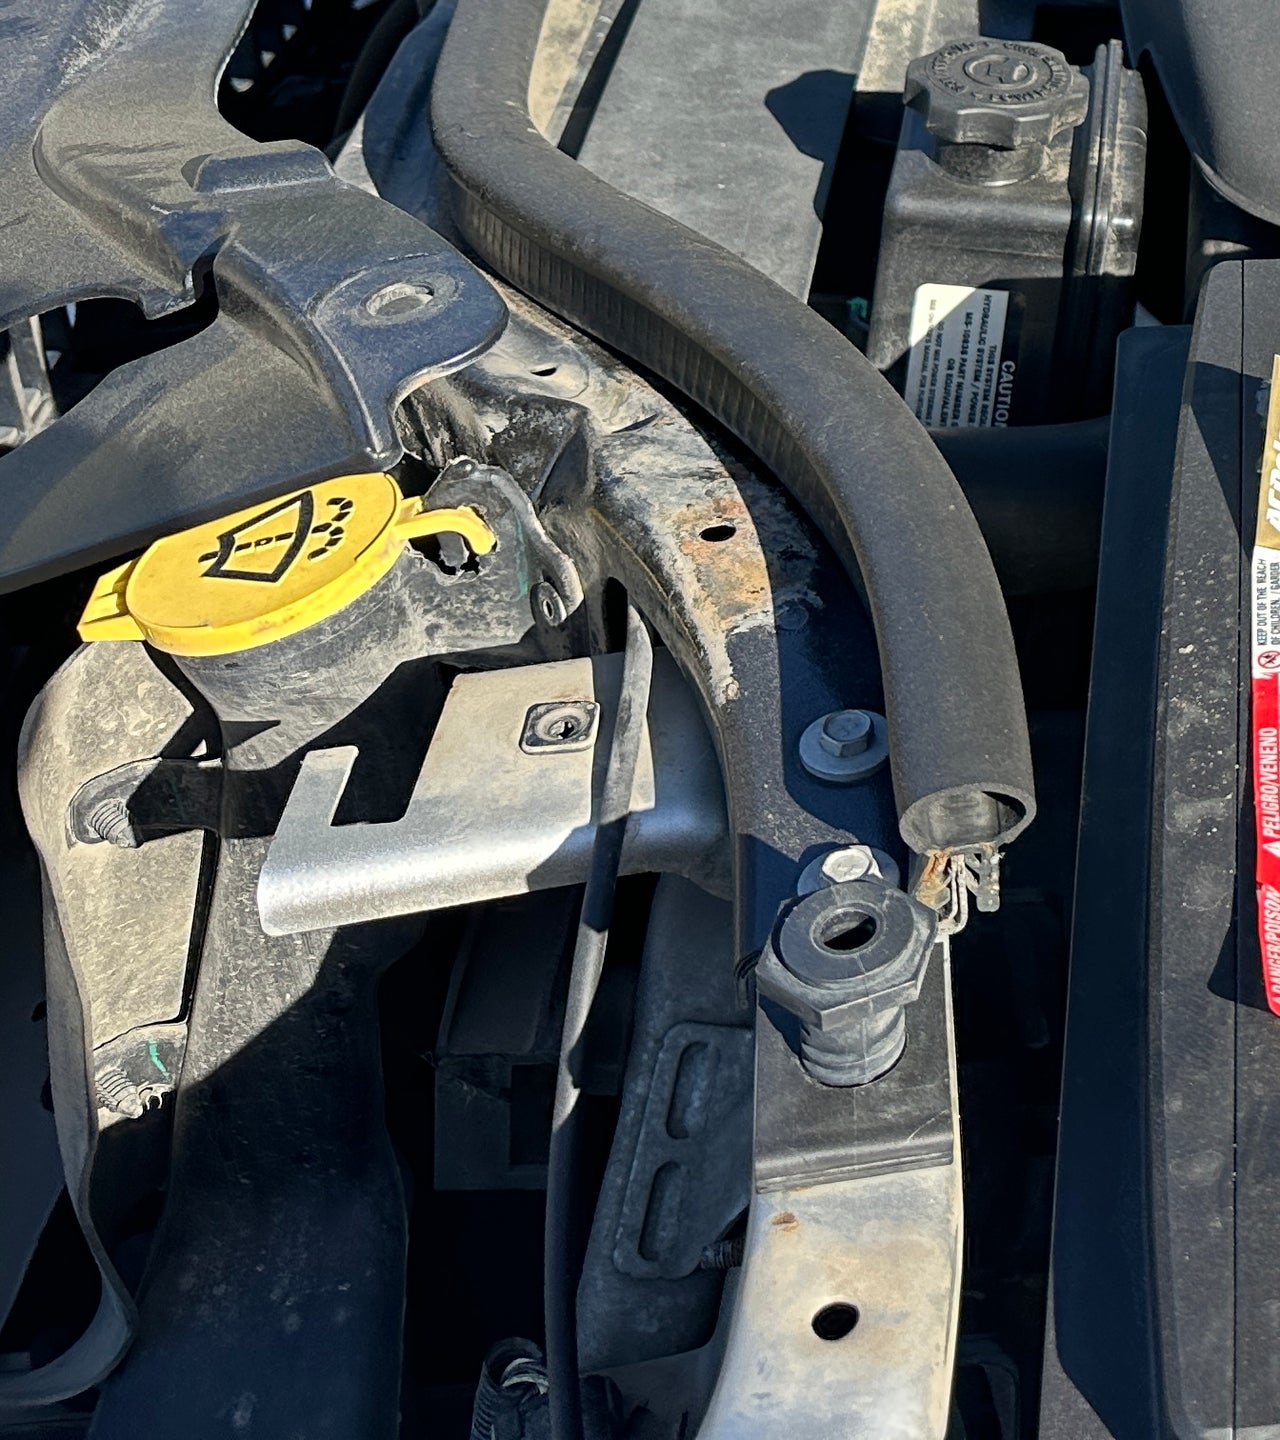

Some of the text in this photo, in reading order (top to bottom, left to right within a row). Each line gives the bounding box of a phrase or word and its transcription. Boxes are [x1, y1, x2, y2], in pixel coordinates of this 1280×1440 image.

[977, 294, 992, 346] HYDRAULIC
[935, 333, 943, 348] NOT
[930, 363, 939, 387] POWER
[947, 358, 955, 371] OR
[958, 358, 967, 380] PART
[974, 348, 985, 382] SYSTEM
[983, 368, 994, 401] SYSTEM
[952, 382, 964, 420] NUMBER
[968, 391, 979, 423] POWER
[1270, 562, 1280, 590] GARDER
[1256, 559, 1267, 645] KEEP OUT THE REACH
[1258, 728, 1280, 839] PELIGRO/VENENO
